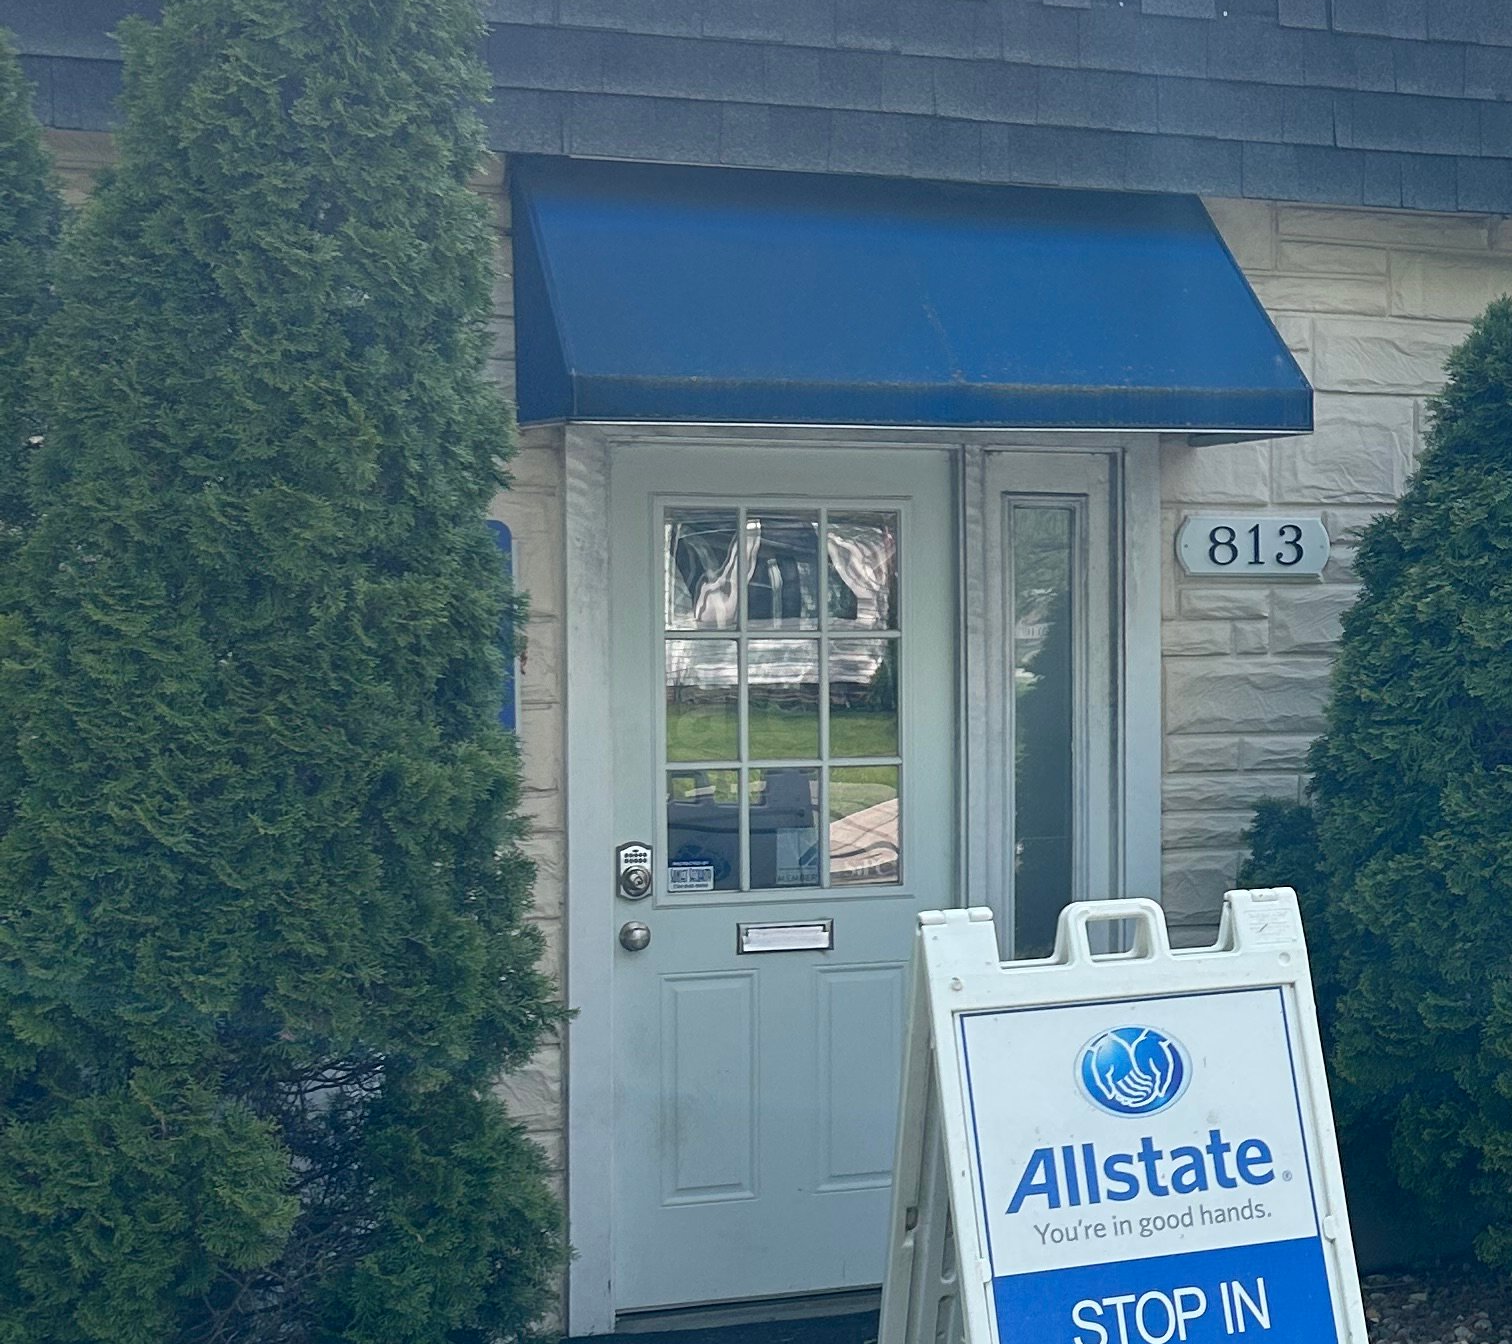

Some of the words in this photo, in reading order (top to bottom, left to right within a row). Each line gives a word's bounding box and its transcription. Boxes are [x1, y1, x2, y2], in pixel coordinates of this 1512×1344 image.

[1208, 523, 1304, 566] 813
[1005, 1129, 1276, 1215] Allstate
[1033, 1219, 1107, 1246] You're
[1112, 1215, 1133, 1237] in
[1139, 1205, 1195, 1238] good
[1199, 1197, 1273, 1226] hands.
[1219, 1277, 1271, 1335] IN
